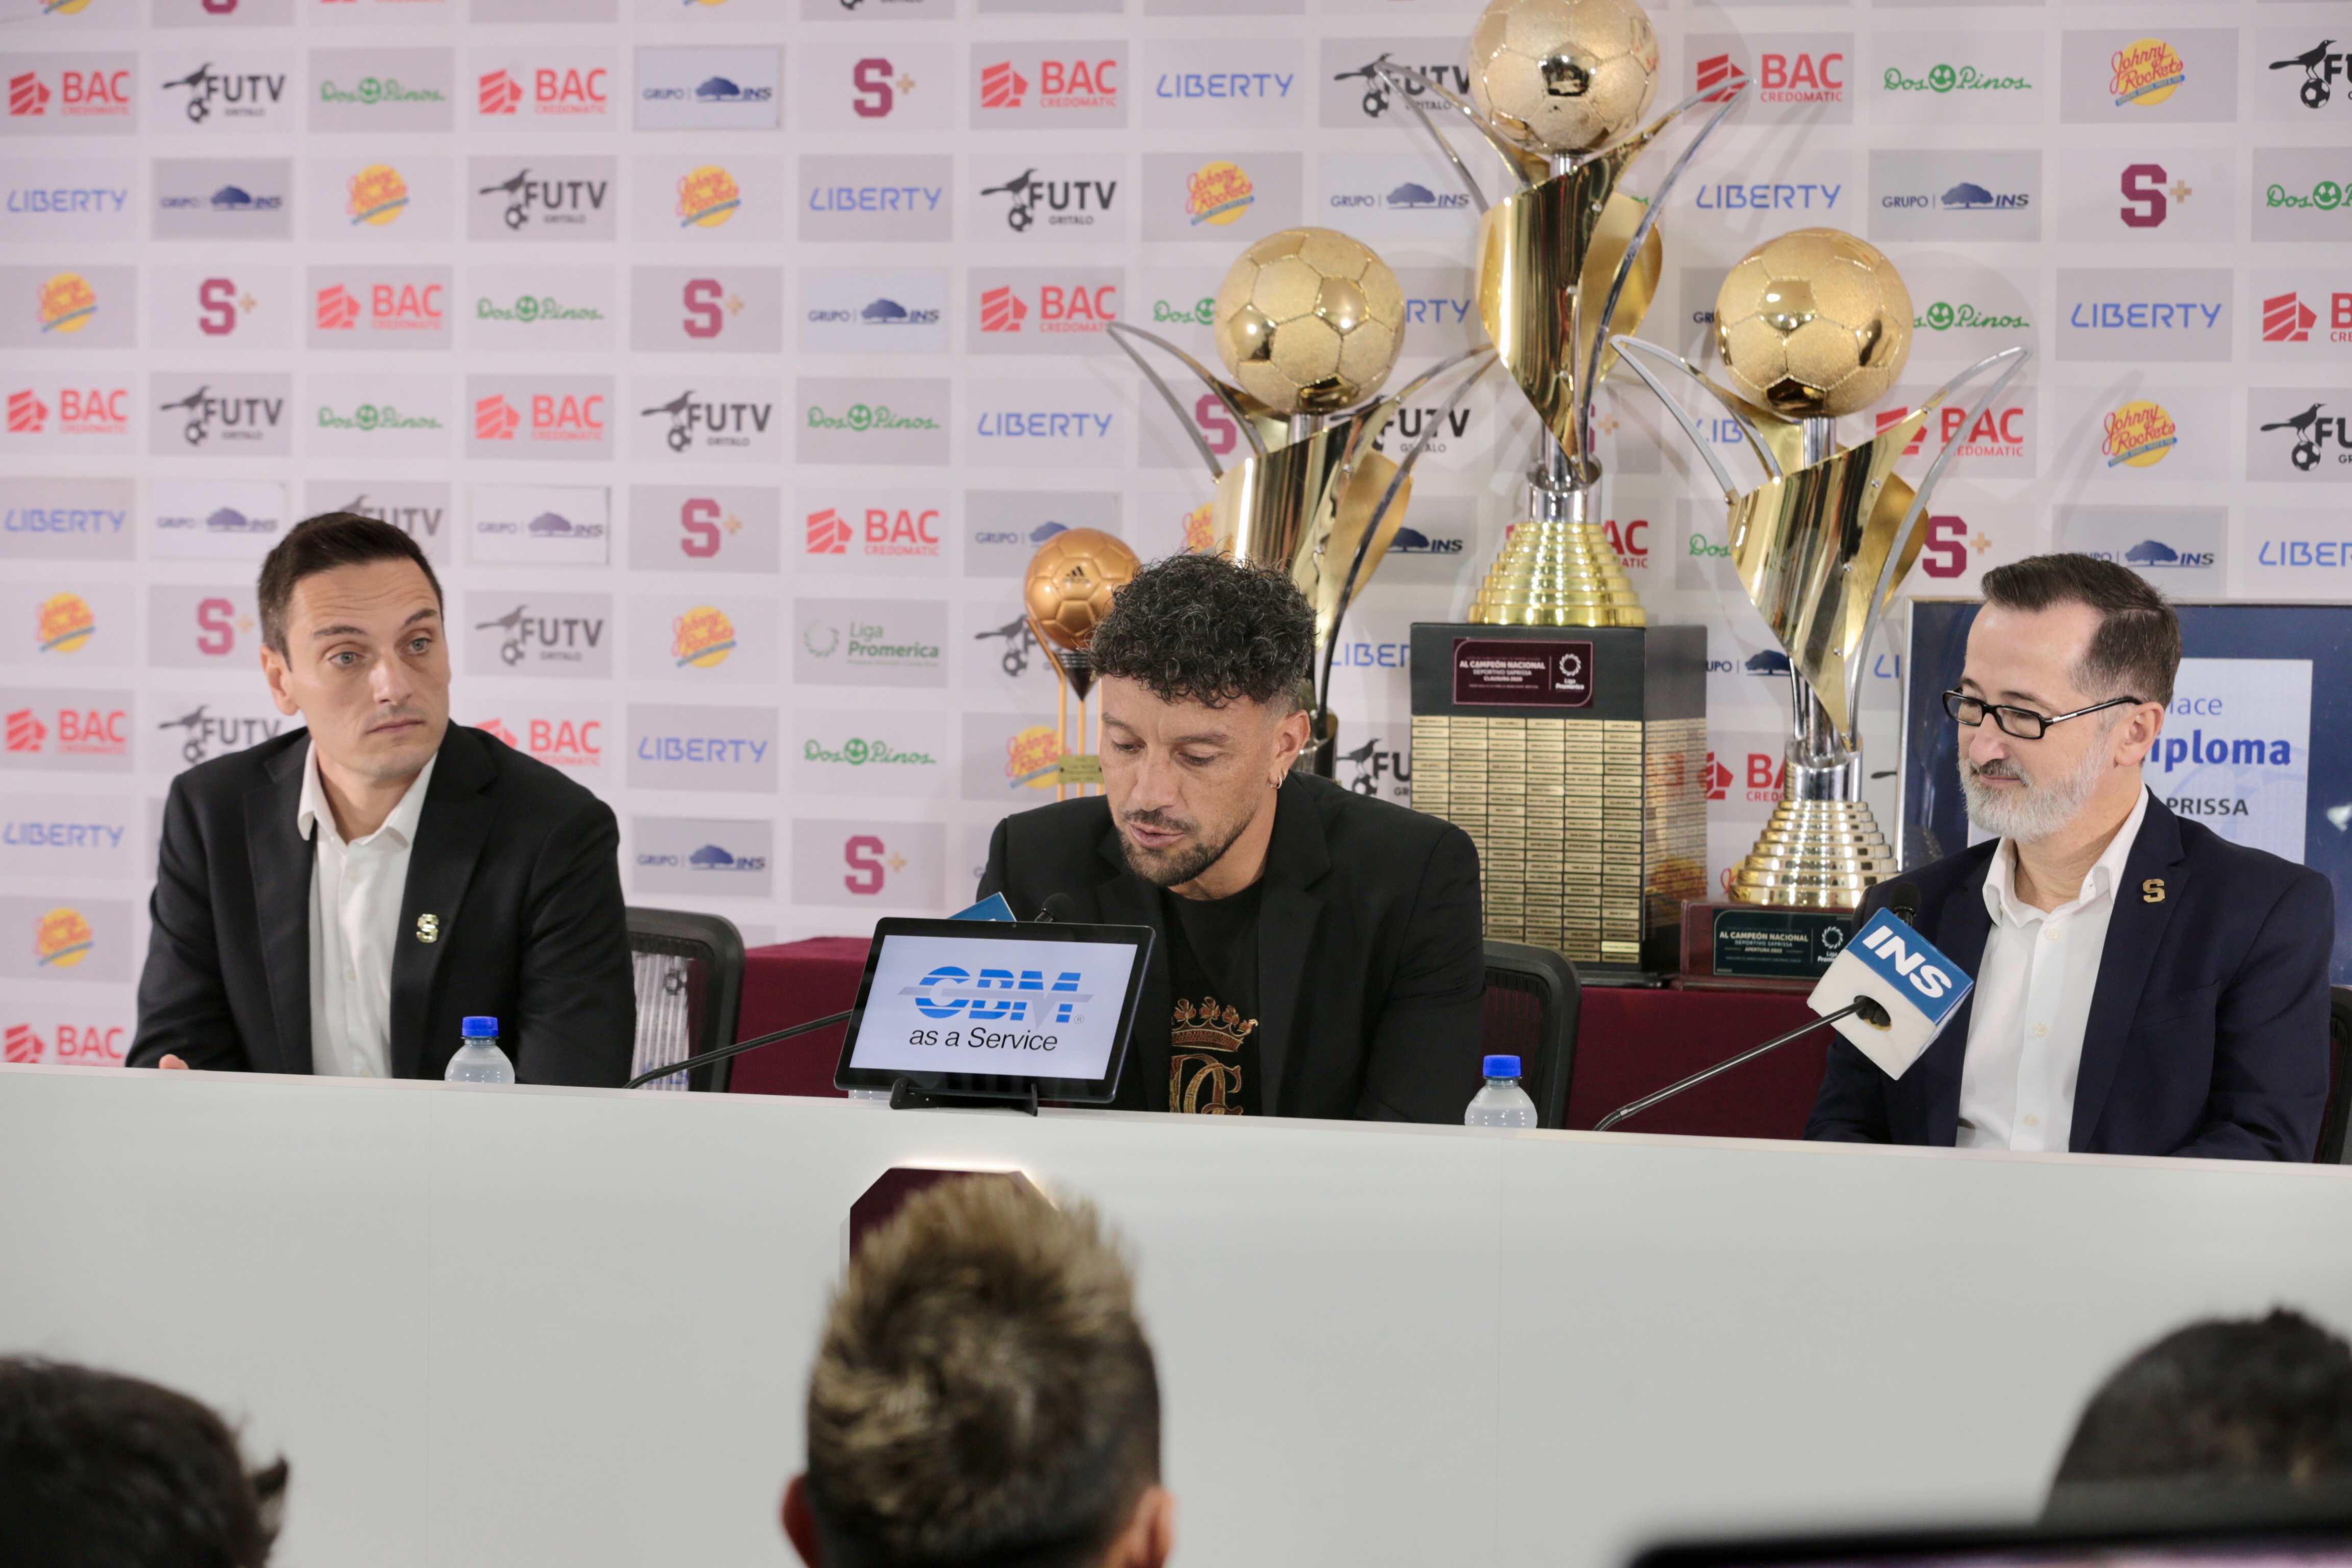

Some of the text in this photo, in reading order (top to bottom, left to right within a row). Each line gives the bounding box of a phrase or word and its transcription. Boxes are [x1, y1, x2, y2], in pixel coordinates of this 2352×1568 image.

[1041, 60, 1116, 95] BAC
[1761, 53, 1843, 89] BAC
[1884, 65, 2031, 90] Dos Pinos
[2119, 58, 2184, 95] Rockets
[63, 70, 129, 104] BAC
[205, 75, 285, 103] FUTV
[536, 68, 606, 102] BAC
[644, 88, 771, 101] GRUPO INS
[1157, 74, 1293, 97] LIBERTY
[1761, 91, 1841, 102] CREDOMATIC
[535, 105, 605, 114] CREDOMATIC
[1041, 97, 1115, 107] CREDOMATIC
[6, 189, 127, 213] LIBERTY
[525, 181, 607, 209] FUTV
[810, 187, 941, 211] LIBERTY
[1028, 182, 1116, 210] FUTV
[1331, 194, 1468, 208] GRUPO INS
[1696, 184, 1841, 209] LIBERTY
[1882, 194, 2028, 208] GRUPO INS
[2267, 184, 2312, 208] Dos
[1049, 215, 1094, 225] GRITALO
[373, 284, 442, 318] BAC
[1041, 286, 1116, 320] BAC
[1154, 300, 1194, 323] Dos
[809, 310, 939, 322] GRUPO INS
[1040, 322, 1106, 333] CREDOMAT
[1955, 304, 2029, 328] Pinos
[2071, 303, 2221, 328] LIBERTY
[60, 389, 127, 423] BAC
[205, 398, 283, 426] FUTV
[532, 395, 603, 429] BAC
[688, 404, 771, 432] FUTV
[808, 406, 940, 429] Dos Pinos
[978, 413, 1112, 436] LIBERTY
[1942, 407, 2023, 444] BAC
[1400, 444, 1446, 452] GALO
[2111, 420, 2175, 456] Rockets
[1942, 446, 2023, 457] EDOMATIC
[5, 509, 125, 533] LIBERTY
[866, 509, 939, 544] BAC
[975, 532, 1018, 544] GRUPO
[1432, 540, 1462, 551] INS
[1604, 520, 1648, 555] AC
[1689, 533, 1730, 557] Dos
[865, 546, 938, 556] CREDOMATIC
[2180, 553, 2214, 566] INS
[521, 620, 603, 647] FUTV
[850, 623, 884, 641] Liga
[848, 641, 939, 658] Promerica
[1459, 660, 1469, 669] AL
[1507, 661, 1546, 670] NACIONAL
[1706, 661, 1731, 672] UPO
[2170, 699, 2222, 716] lace
[59, 709, 125, 742] BAC
[202, 720, 280, 745] FUTV
[530, 721, 600, 754] BAC
[638, 738, 767, 763] LIBERTY
[804, 739, 936, 765] Dos Pinos
[2150, 730, 2291, 773] iploma
[2166, 798, 2249, 816] PRISSA
[3, 822, 124, 847] LIBERTY
[638, 855, 765, 870] GRUPO INS
[1730, 932, 1768, 940] CAMPEÓN
[1770, 933, 1808, 942] NACIONAL
[1862, 925, 1952, 998] INS
[915, 966, 1081, 1023] CBM
[57, 1025, 125, 1058] BAC
[910, 1027, 1058, 1051] as a Service
